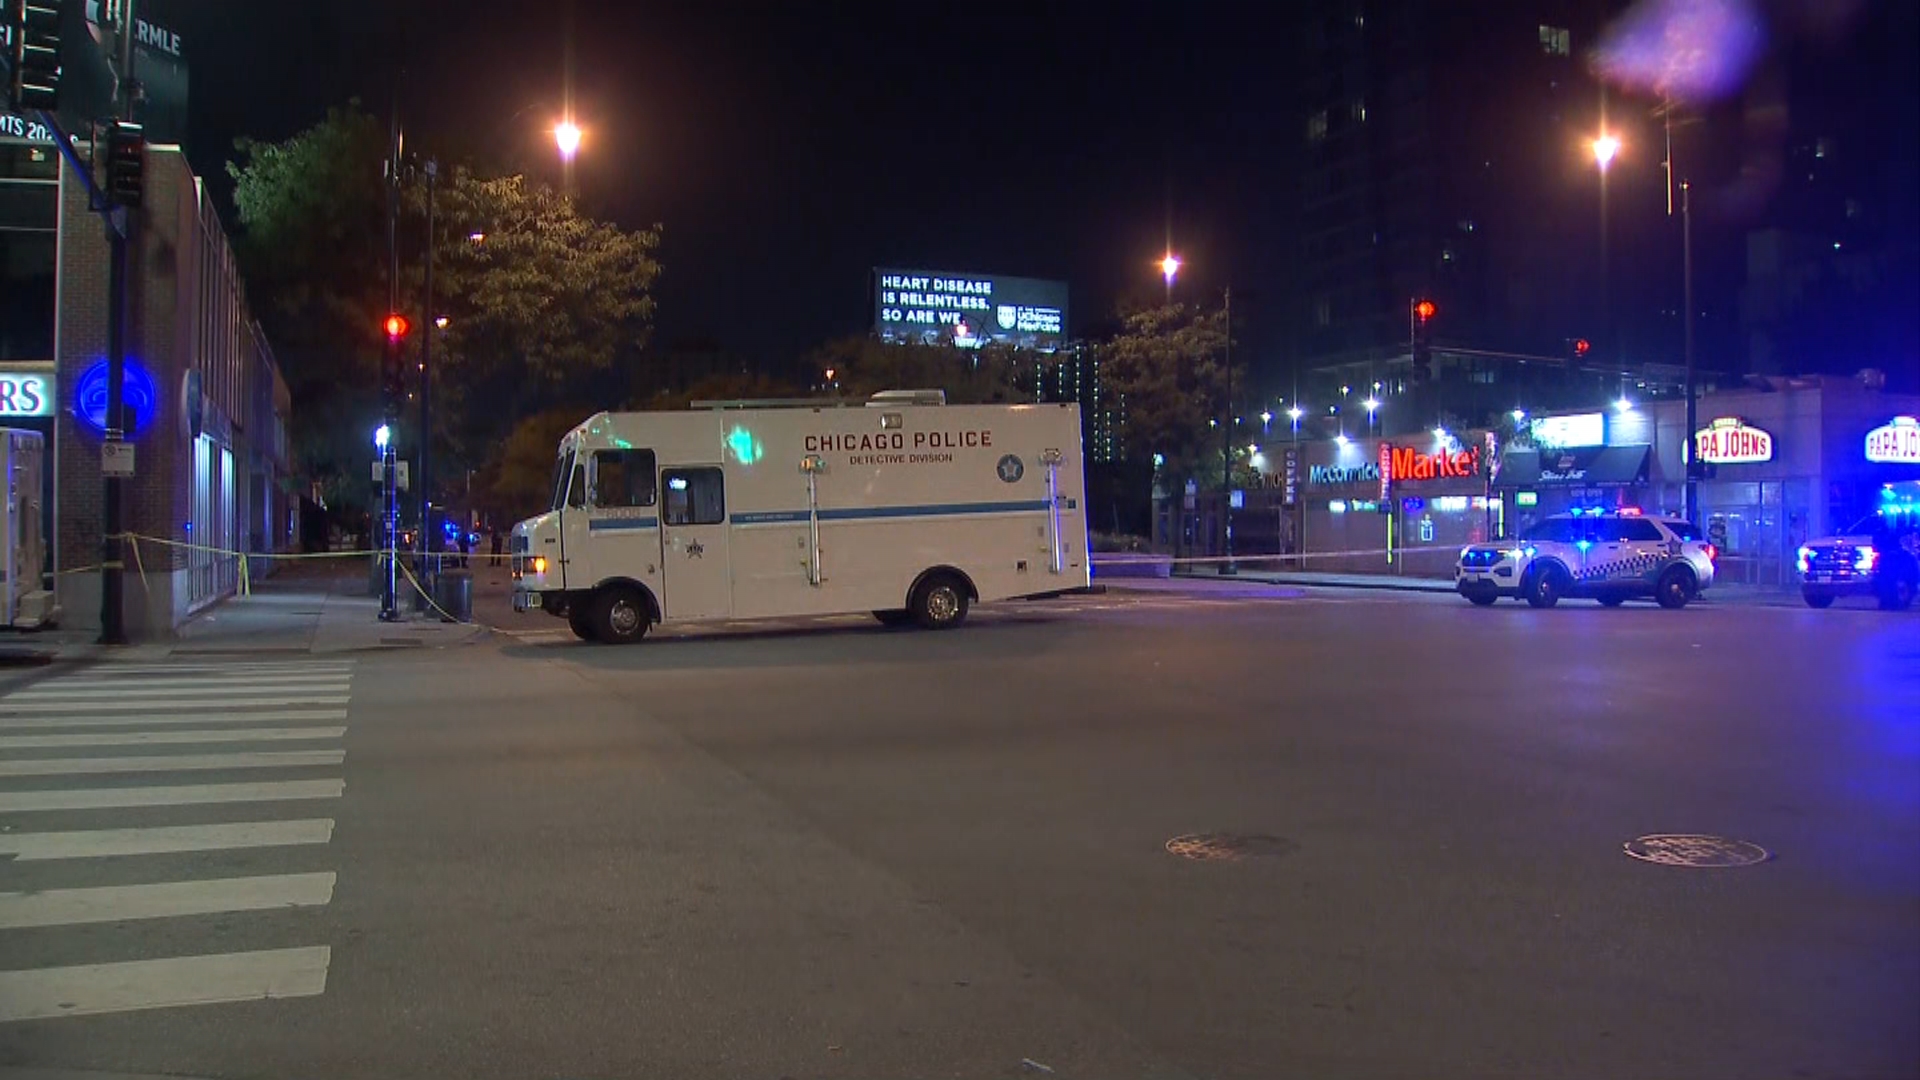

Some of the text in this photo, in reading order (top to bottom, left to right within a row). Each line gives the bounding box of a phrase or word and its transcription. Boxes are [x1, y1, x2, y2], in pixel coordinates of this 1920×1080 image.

[135, 18, 181, 56] RMLE
[882, 276, 992, 293] HEART DISEASE
[882, 292, 990, 310] IS RELENTLESS,
[882, 309, 902, 322] SO
[906, 311, 935, 323] ARE
[0, 380, 40, 411] RS
[805, 431, 992, 451] CHICAGO POLICE
[1723, 430, 1766, 458] JOHNS
[1870, 430, 1920, 457] PAPA JO
[850, 453, 953, 465] DETECTIVE DIVISION
[1391, 446, 1479, 480] Market
